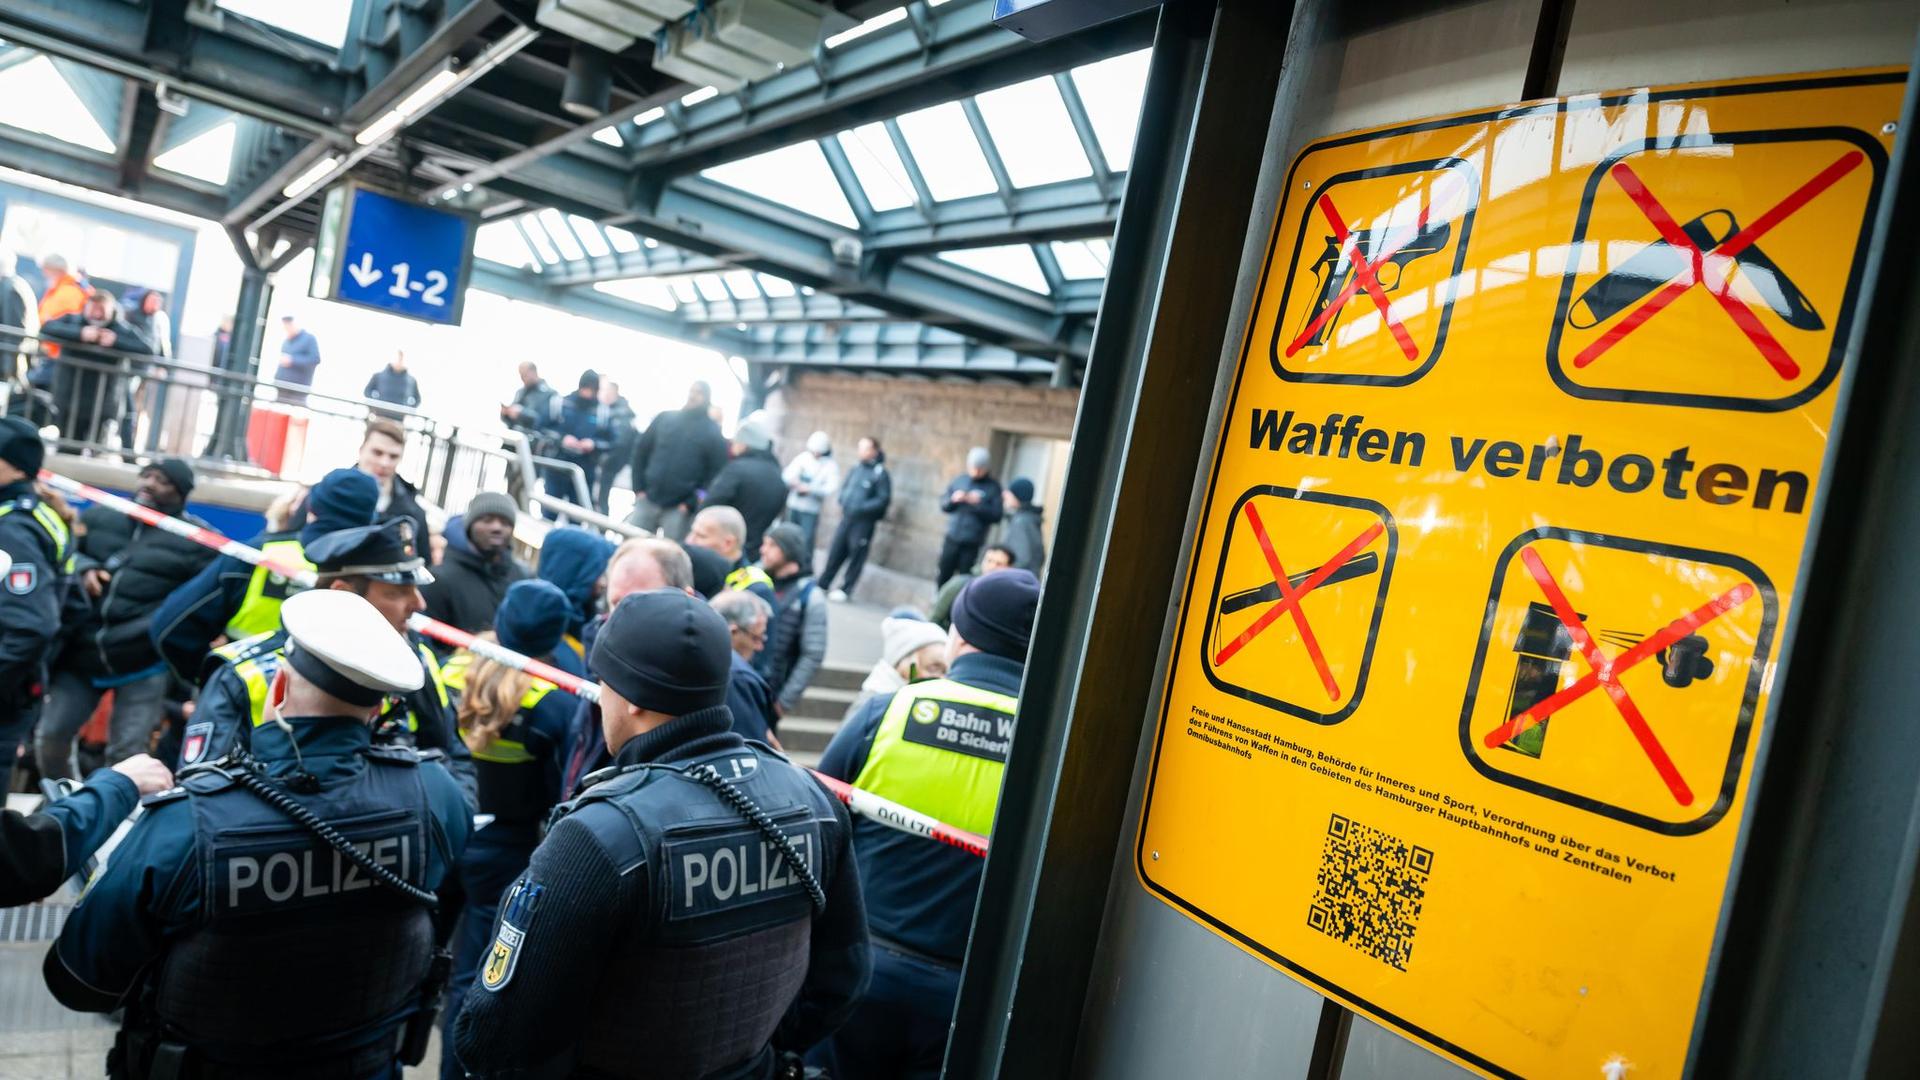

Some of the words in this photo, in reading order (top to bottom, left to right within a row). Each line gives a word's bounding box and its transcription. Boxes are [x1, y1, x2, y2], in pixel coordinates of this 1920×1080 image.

[388, 262, 448, 307] 1-2
[1249, 408, 1426, 467] Waffen
[1450, 434, 1811, 514] verboten
[936, 726, 959, 742] DB
[940, 707, 992, 735] Bahn
[1186, 726, 1253, 761] Omnibusbahnhofs
[1189, 717, 1203, 728] des
[1203, 720, 1233, 741] Führens
[1234, 734, 1249, 746] von
[1250, 739, 1279, 757] Waffen
[1280, 750, 1289, 761] in
[1290, 755, 1308, 769] den
[1309, 761, 1352, 784] Gebieten
[1354, 778, 1373, 793] des
[1375, 785, 1436, 814] Hamburger
[1438, 808, 1530, 849] Hauptbahnhofs
[1534, 842, 1559, 859] und
[1563, 851, 1633, 884] Zentralen
[1191, 705, 1210, 719] Freie
[1211, 712, 1226, 724] und
[1226, 718, 1272, 742] Hansestadt
[1273, 733, 1315, 760] Hamburg,
[1317, 751, 1357, 773] Behörde
[1359, 764, 1374, 779] für
[1375, 771, 1416, 793] Inneres
[1419, 787, 1440, 802] und
[1443, 795, 1478, 816] Sport,
[1483, 808, 1557, 844] Verordnung
[1560, 834, 1592, 854] über
[1595, 847, 1621, 865] das
[1626, 856, 1677, 882] Verbot
[228, 835, 411, 908] POLIZEI
